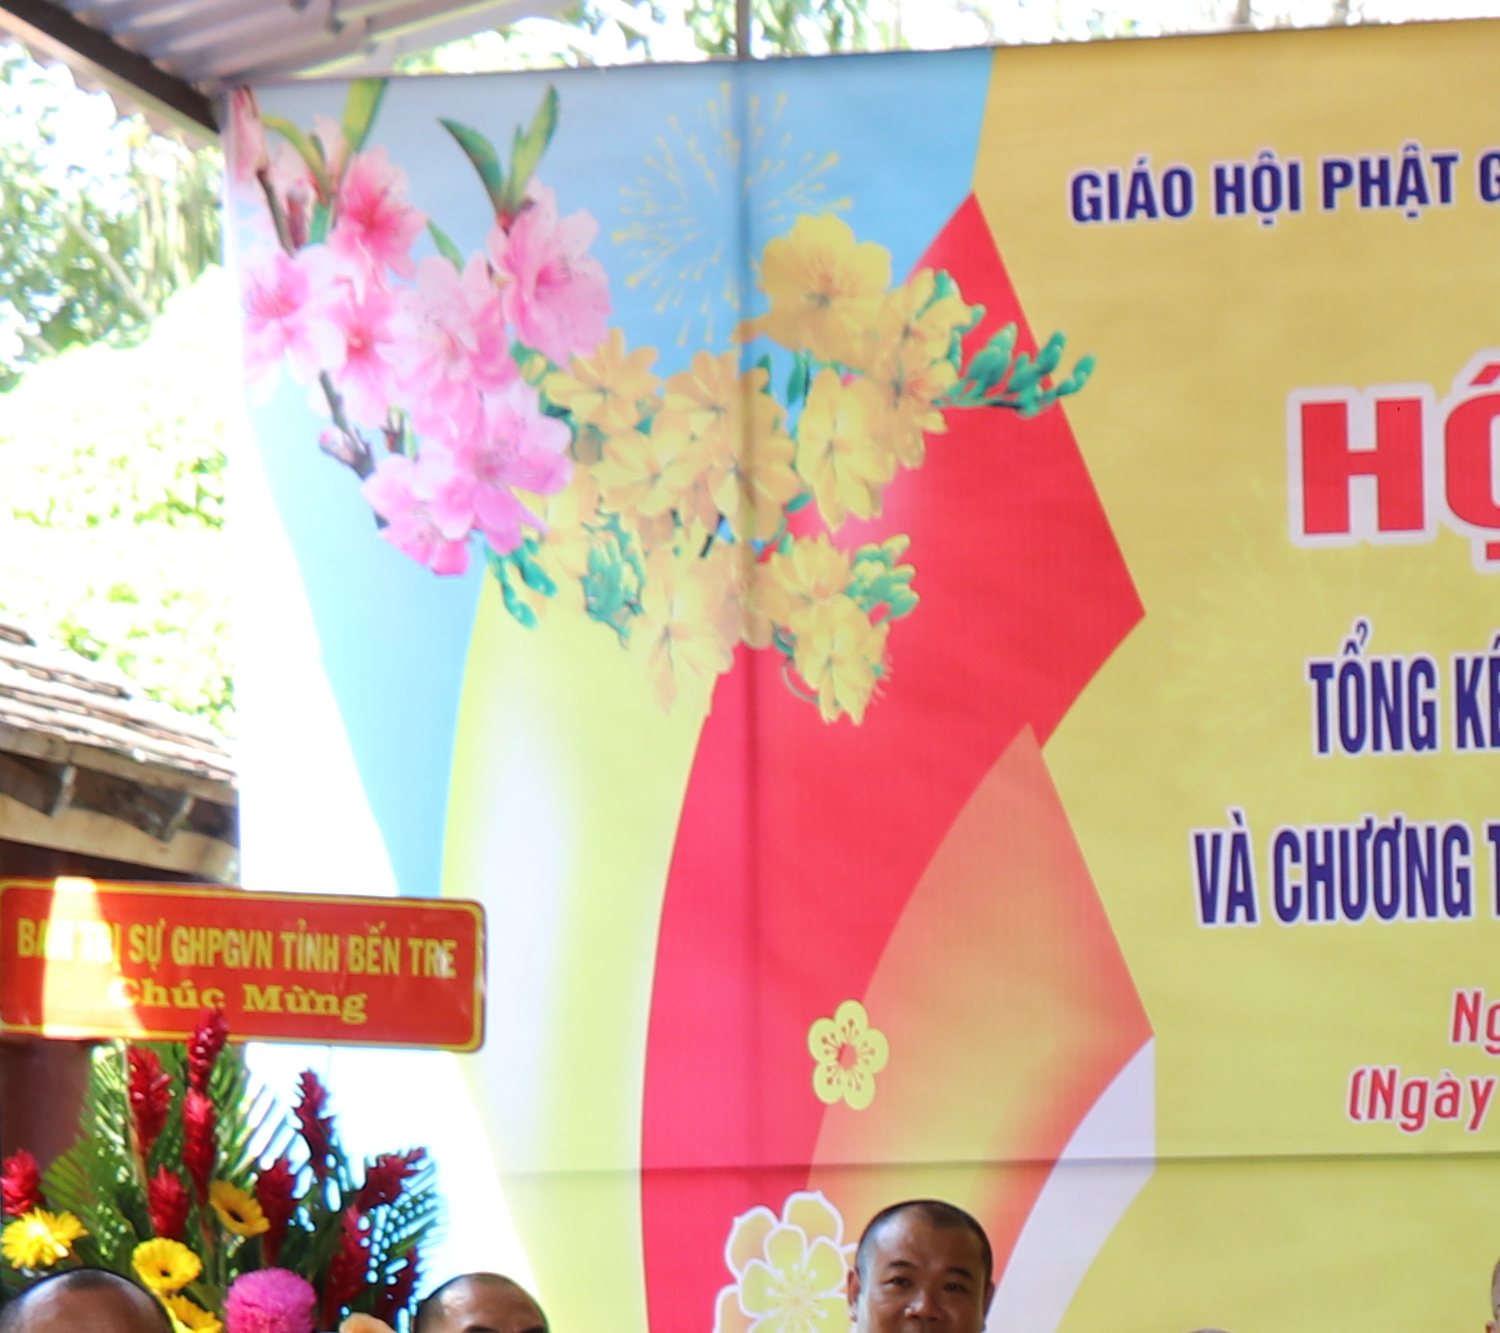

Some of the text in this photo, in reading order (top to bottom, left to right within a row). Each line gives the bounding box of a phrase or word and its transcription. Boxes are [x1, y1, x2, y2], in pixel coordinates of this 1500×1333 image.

[1071, 167, 1193, 223] GIÁO
[1214, 162, 1301, 225] HỘI
[1322, 154, 1459, 218] PHẬT
[1309, 621, 1437, 754] TỔNG
[1194, 811, 1256, 924] VÀ
[1273, 816, 1471, 923] CHƯƠNG
[17, 917, 73, 961] BA
[128, 917, 167, 972] SỰ
[171, 925, 274, 971] GHPGVN
[281, 918, 341, 973] TỈNH
[346, 920, 400, 977] BẾN
[407, 937, 458, 979] TRE
[107, 976, 368, 1026] Chúc Mừng
[1349, 1068, 1495, 1133] (Ngày
